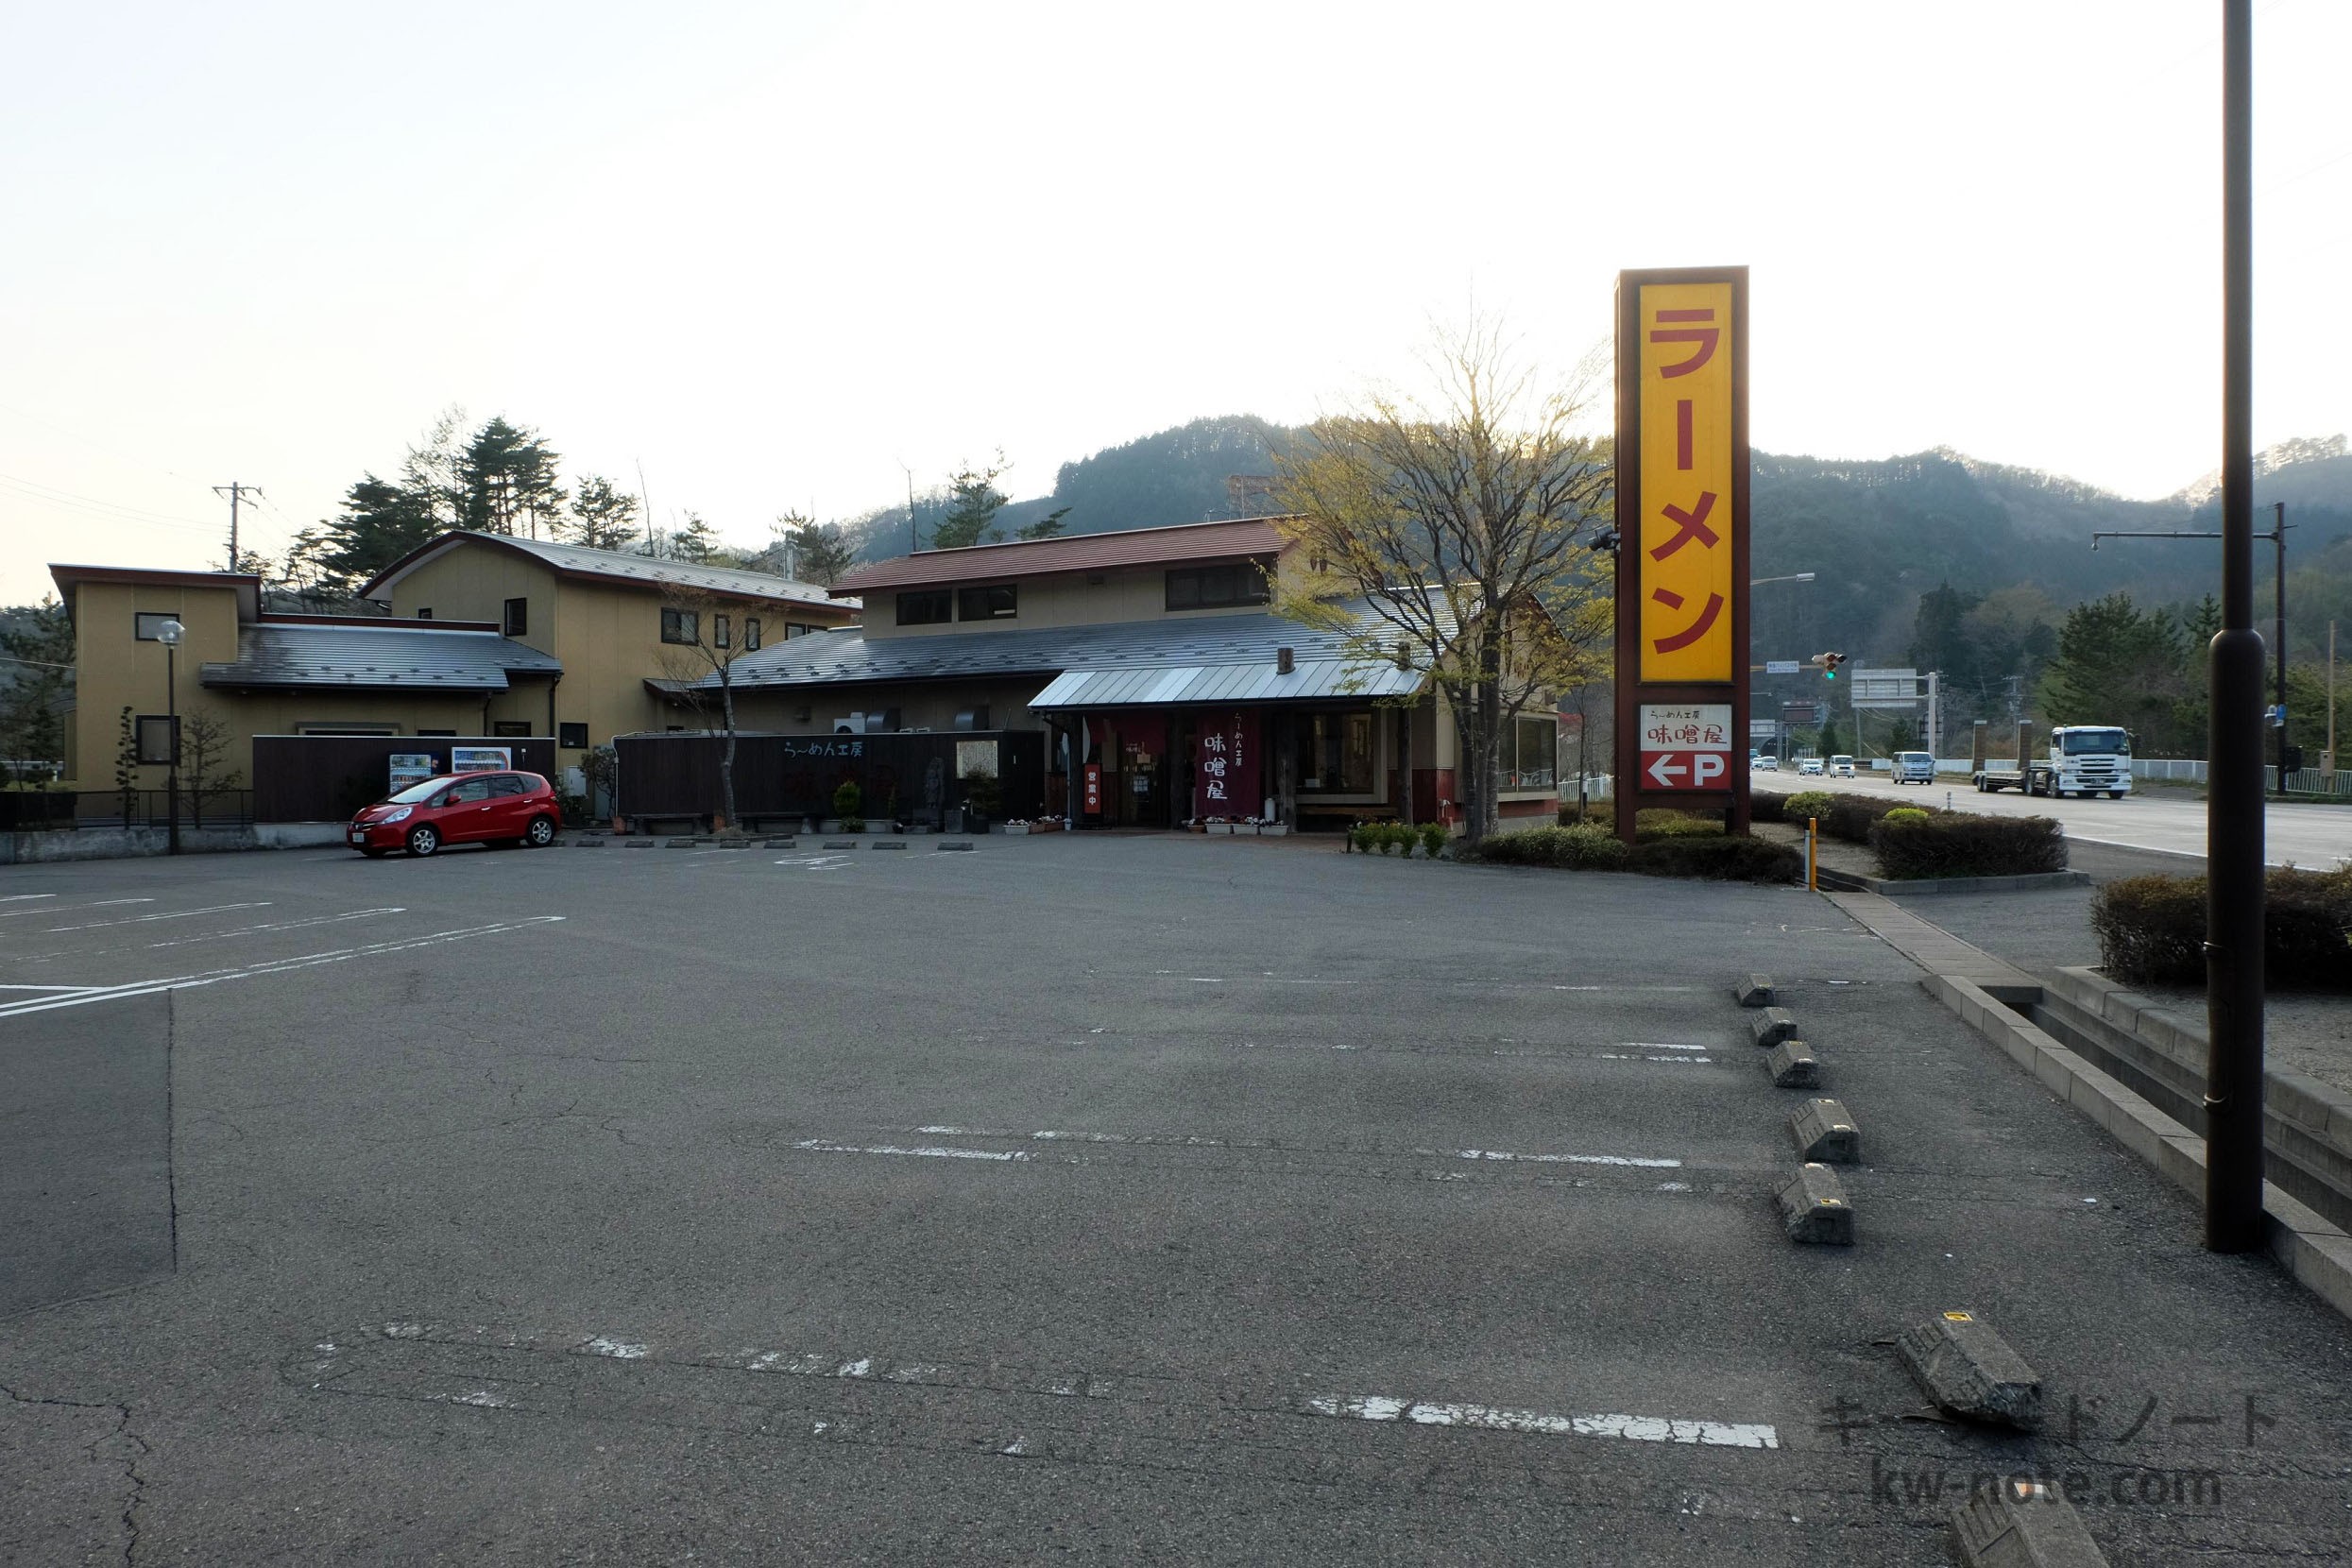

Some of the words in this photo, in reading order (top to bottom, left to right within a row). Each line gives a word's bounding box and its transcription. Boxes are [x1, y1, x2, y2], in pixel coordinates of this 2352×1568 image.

[1649, 309, 1725, 655] ラーメン
[1647, 724, 1728, 744] 味噌屋
[1204, 732, 1228, 799] 味噌屋
[1694, 754, 1725, 786] P
[1088, 772, 1097, 806] 営業中
